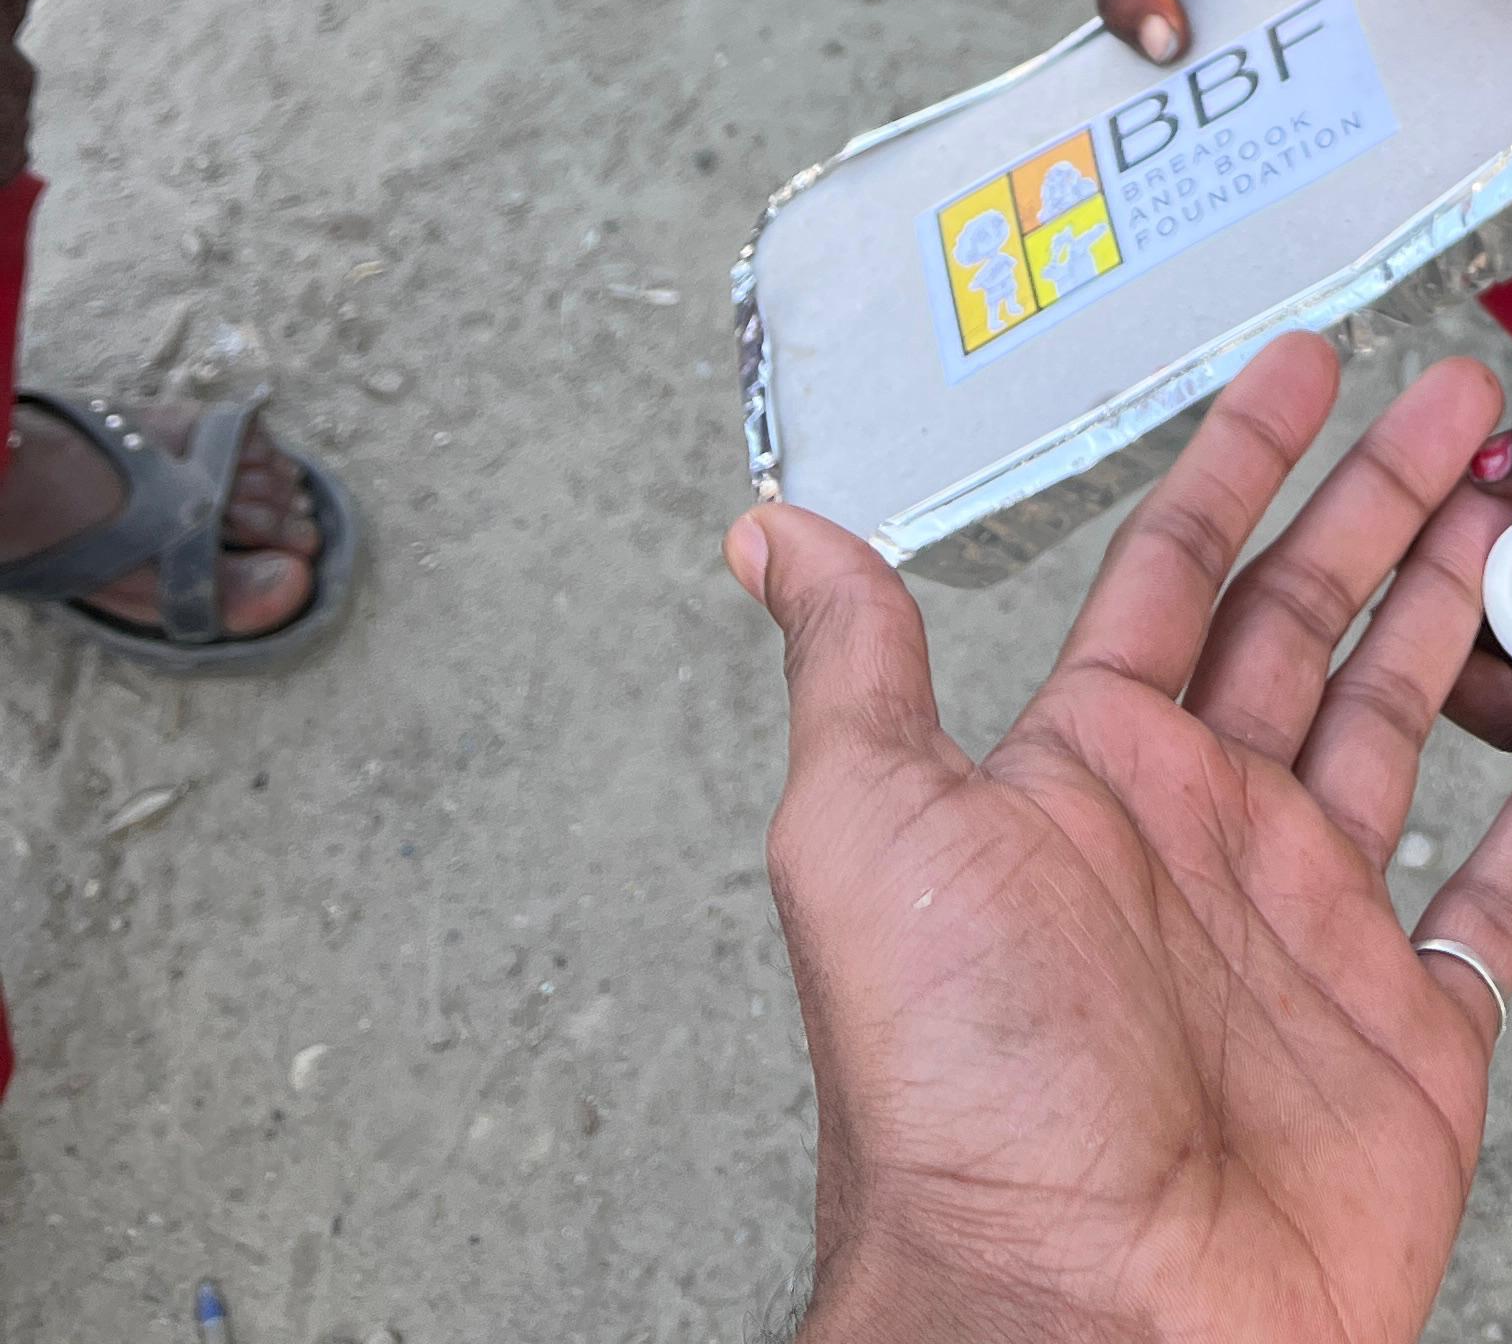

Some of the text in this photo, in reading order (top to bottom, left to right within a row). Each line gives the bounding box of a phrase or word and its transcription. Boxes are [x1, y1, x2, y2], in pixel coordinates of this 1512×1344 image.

[1123, 127, 1234, 202] BREAD
[1129, 112, 1313, 226] AND BOOK
[1136, 111, 1363, 250] FOUNDATION
